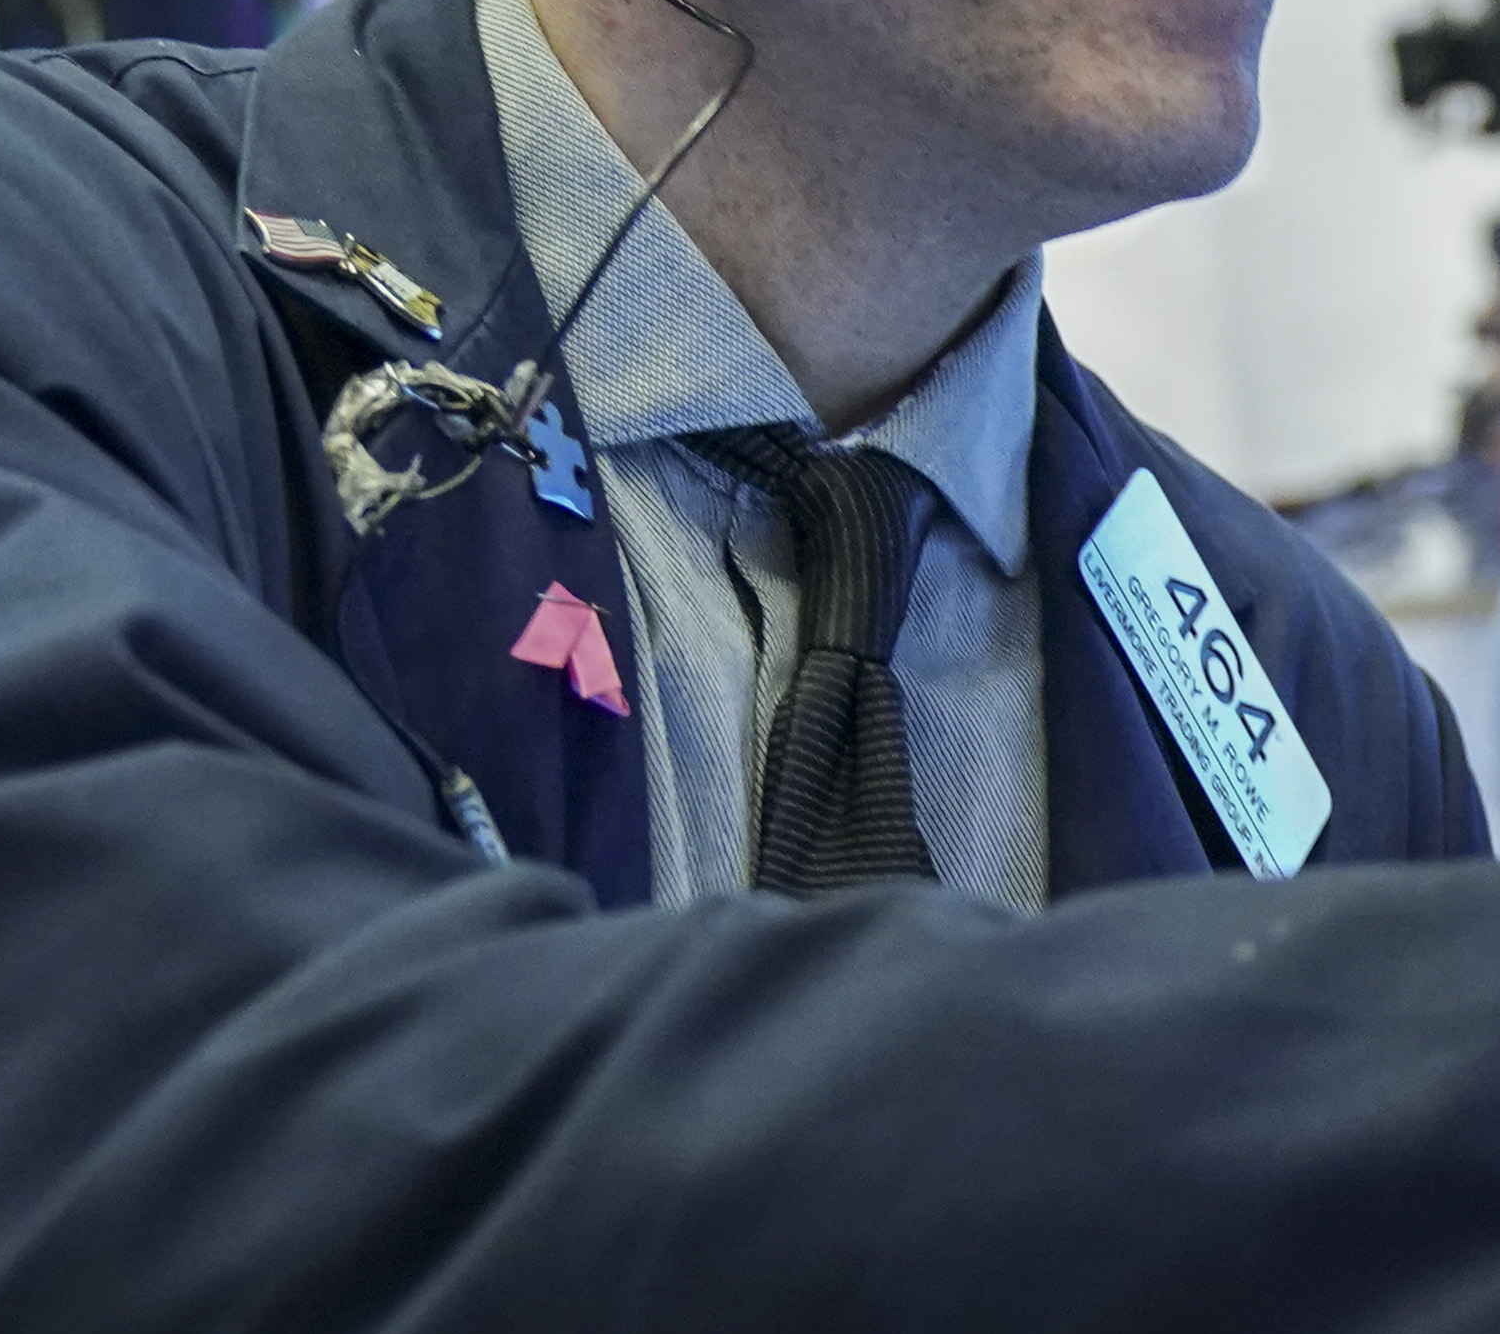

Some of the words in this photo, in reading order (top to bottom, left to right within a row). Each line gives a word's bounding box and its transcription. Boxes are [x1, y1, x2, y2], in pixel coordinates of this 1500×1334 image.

[1084, 551, 1159, 678] LIVERMORE
[1159, 679, 1211, 773] TRADING
[1128, 575, 1202, 698] GREGORY
[1223, 740, 1270, 824] ROWE
[1165, 577, 1276, 765] 464
